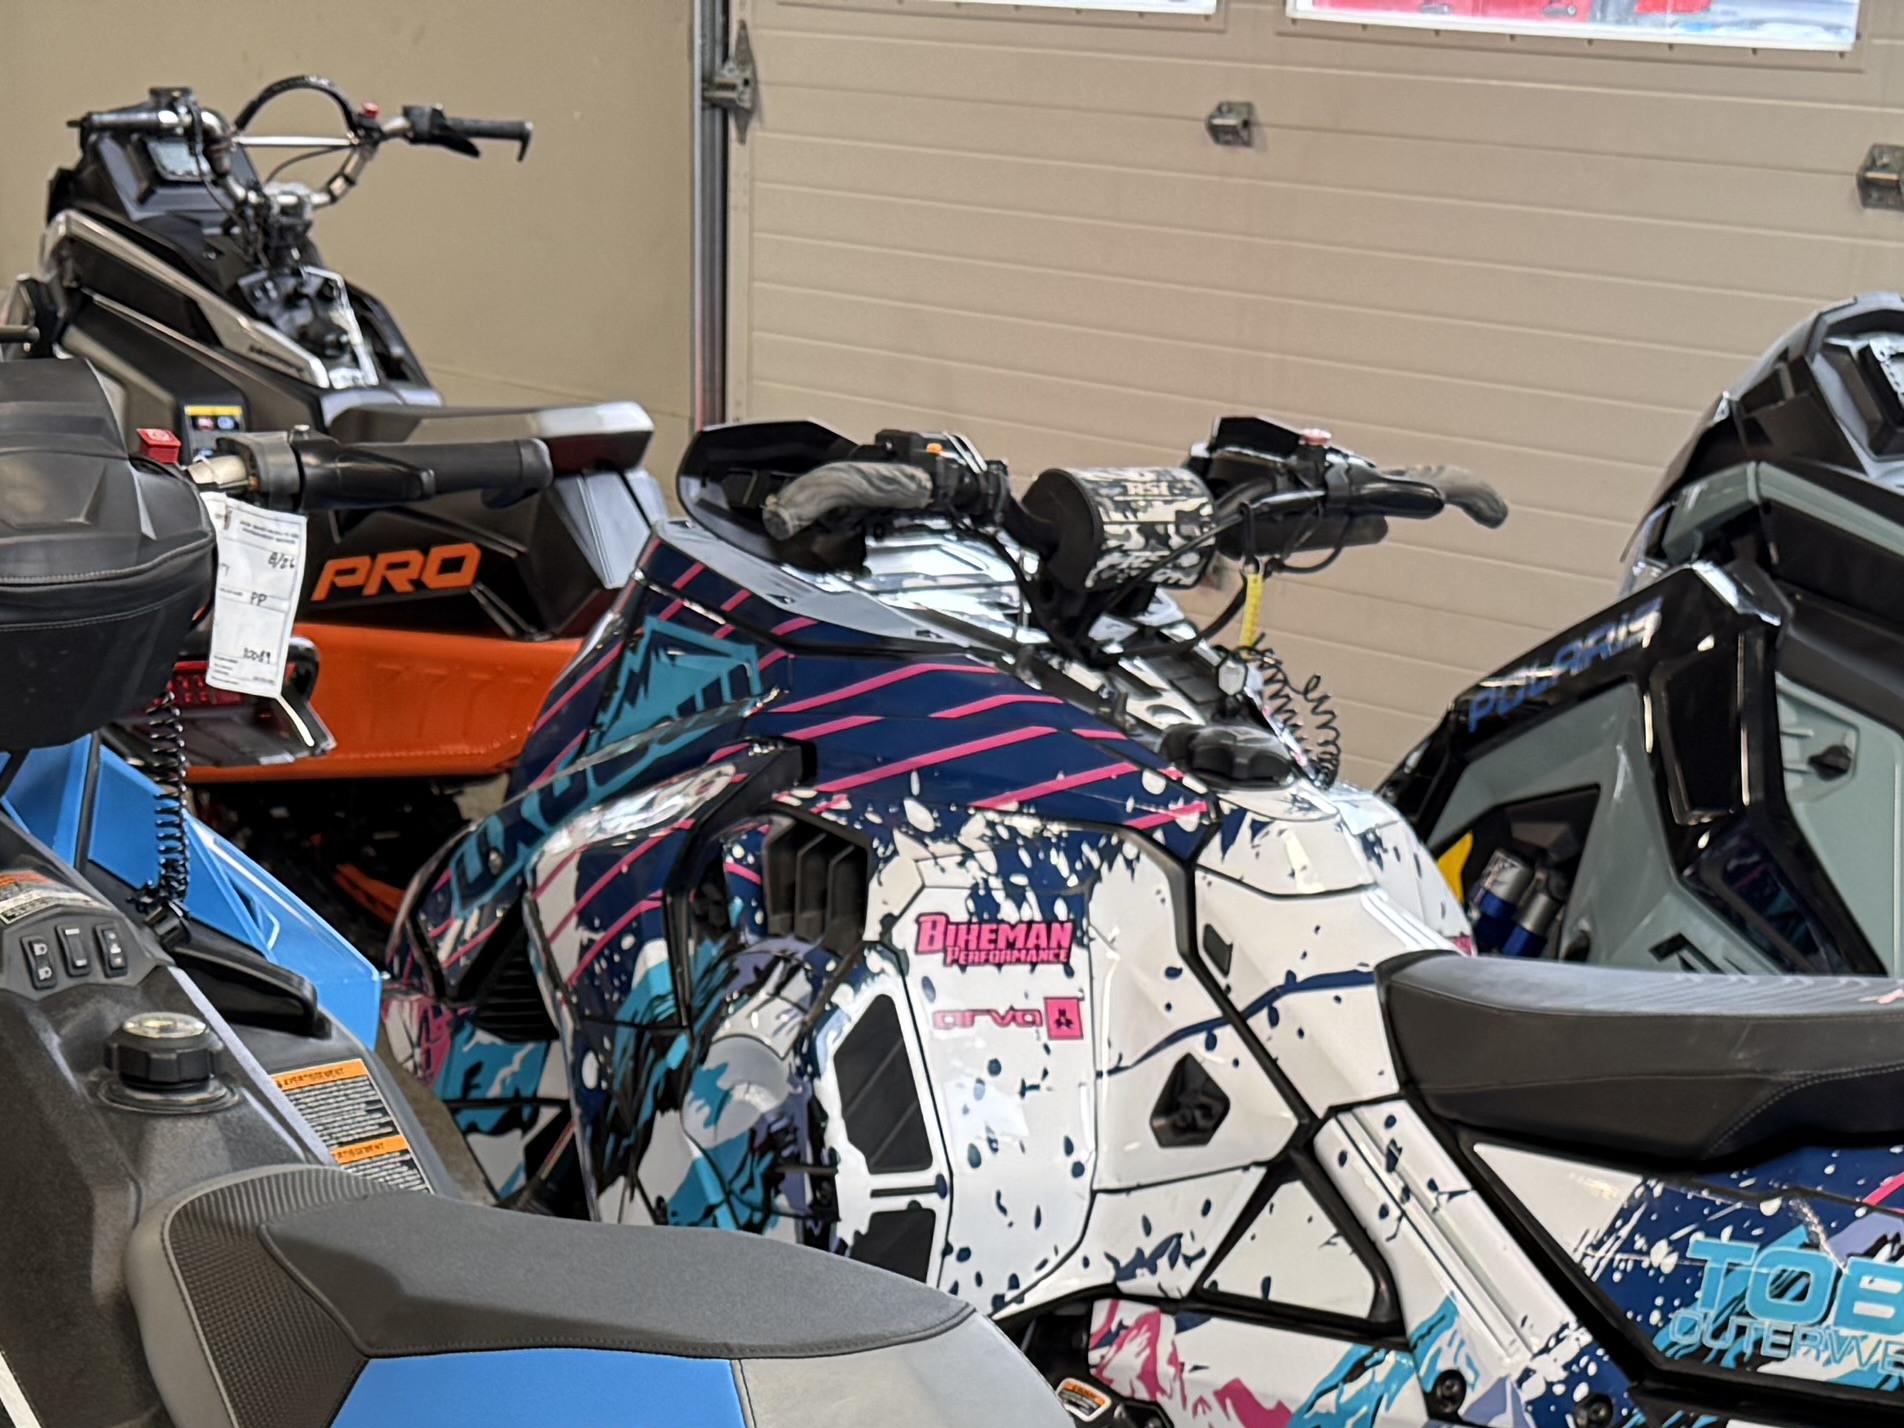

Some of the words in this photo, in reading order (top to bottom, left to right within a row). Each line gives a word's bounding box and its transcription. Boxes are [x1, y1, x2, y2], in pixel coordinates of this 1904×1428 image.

[311, 542, 482, 601] PRO
[1468, 596, 1663, 733] POLARIS
[915, 912, 1073, 954] BIKEMAN
[944, 947, 1069, 966] PERFORMANCE
[932, 1008, 1043, 1029] arva
